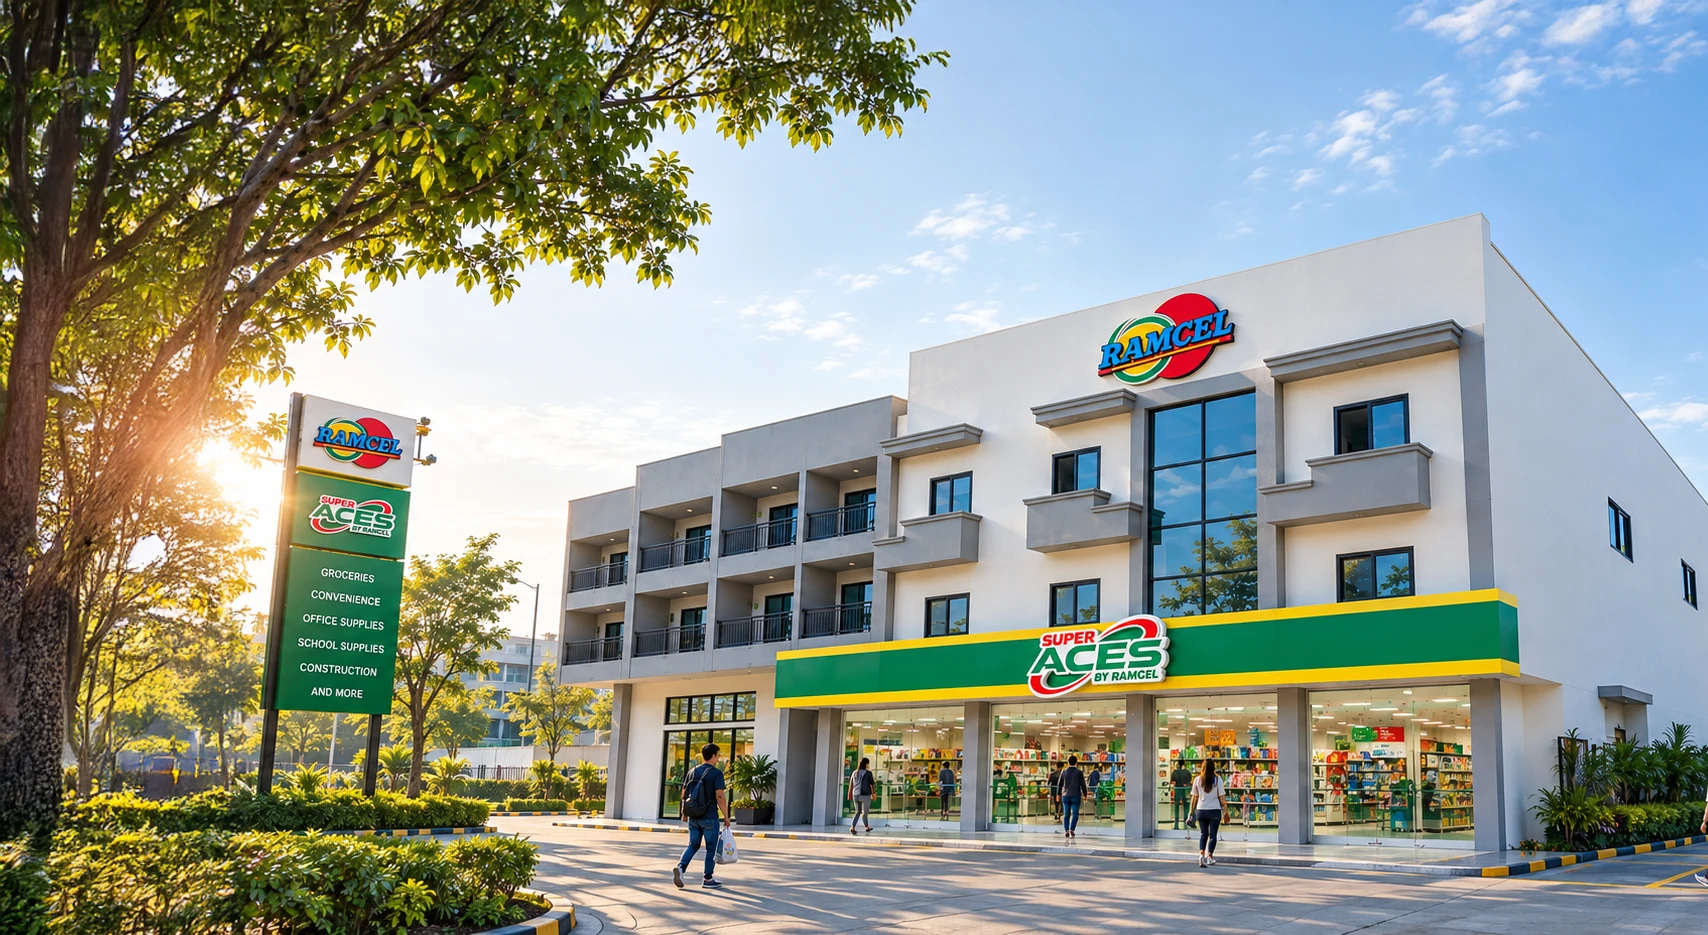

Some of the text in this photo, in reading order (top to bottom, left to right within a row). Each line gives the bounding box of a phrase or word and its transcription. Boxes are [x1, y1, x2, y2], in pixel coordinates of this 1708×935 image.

[1098, 308, 1235, 369] RAMCEL
[313, 425, 403, 455] RAMCEL
[321, 495, 356, 508] SUPER
[311, 504, 394, 530] ACES
[321, 567, 375, 583] GROCERIES
[311, 589, 381, 607] CONVENIENCE
[302, 613, 385, 631] OFFICE SUPPLIES
[297, 637, 385, 654] SCHOOL SUPPLIES
[1041, 630, 1095, 647] SUPER
[1030, 639, 1164, 674] ACES
[299, 662, 377, 677] CONSTRUCTION
[1094, 669, 1159, 682] BY RAMCEL
[311, 687, 363, 699] AND MORE
